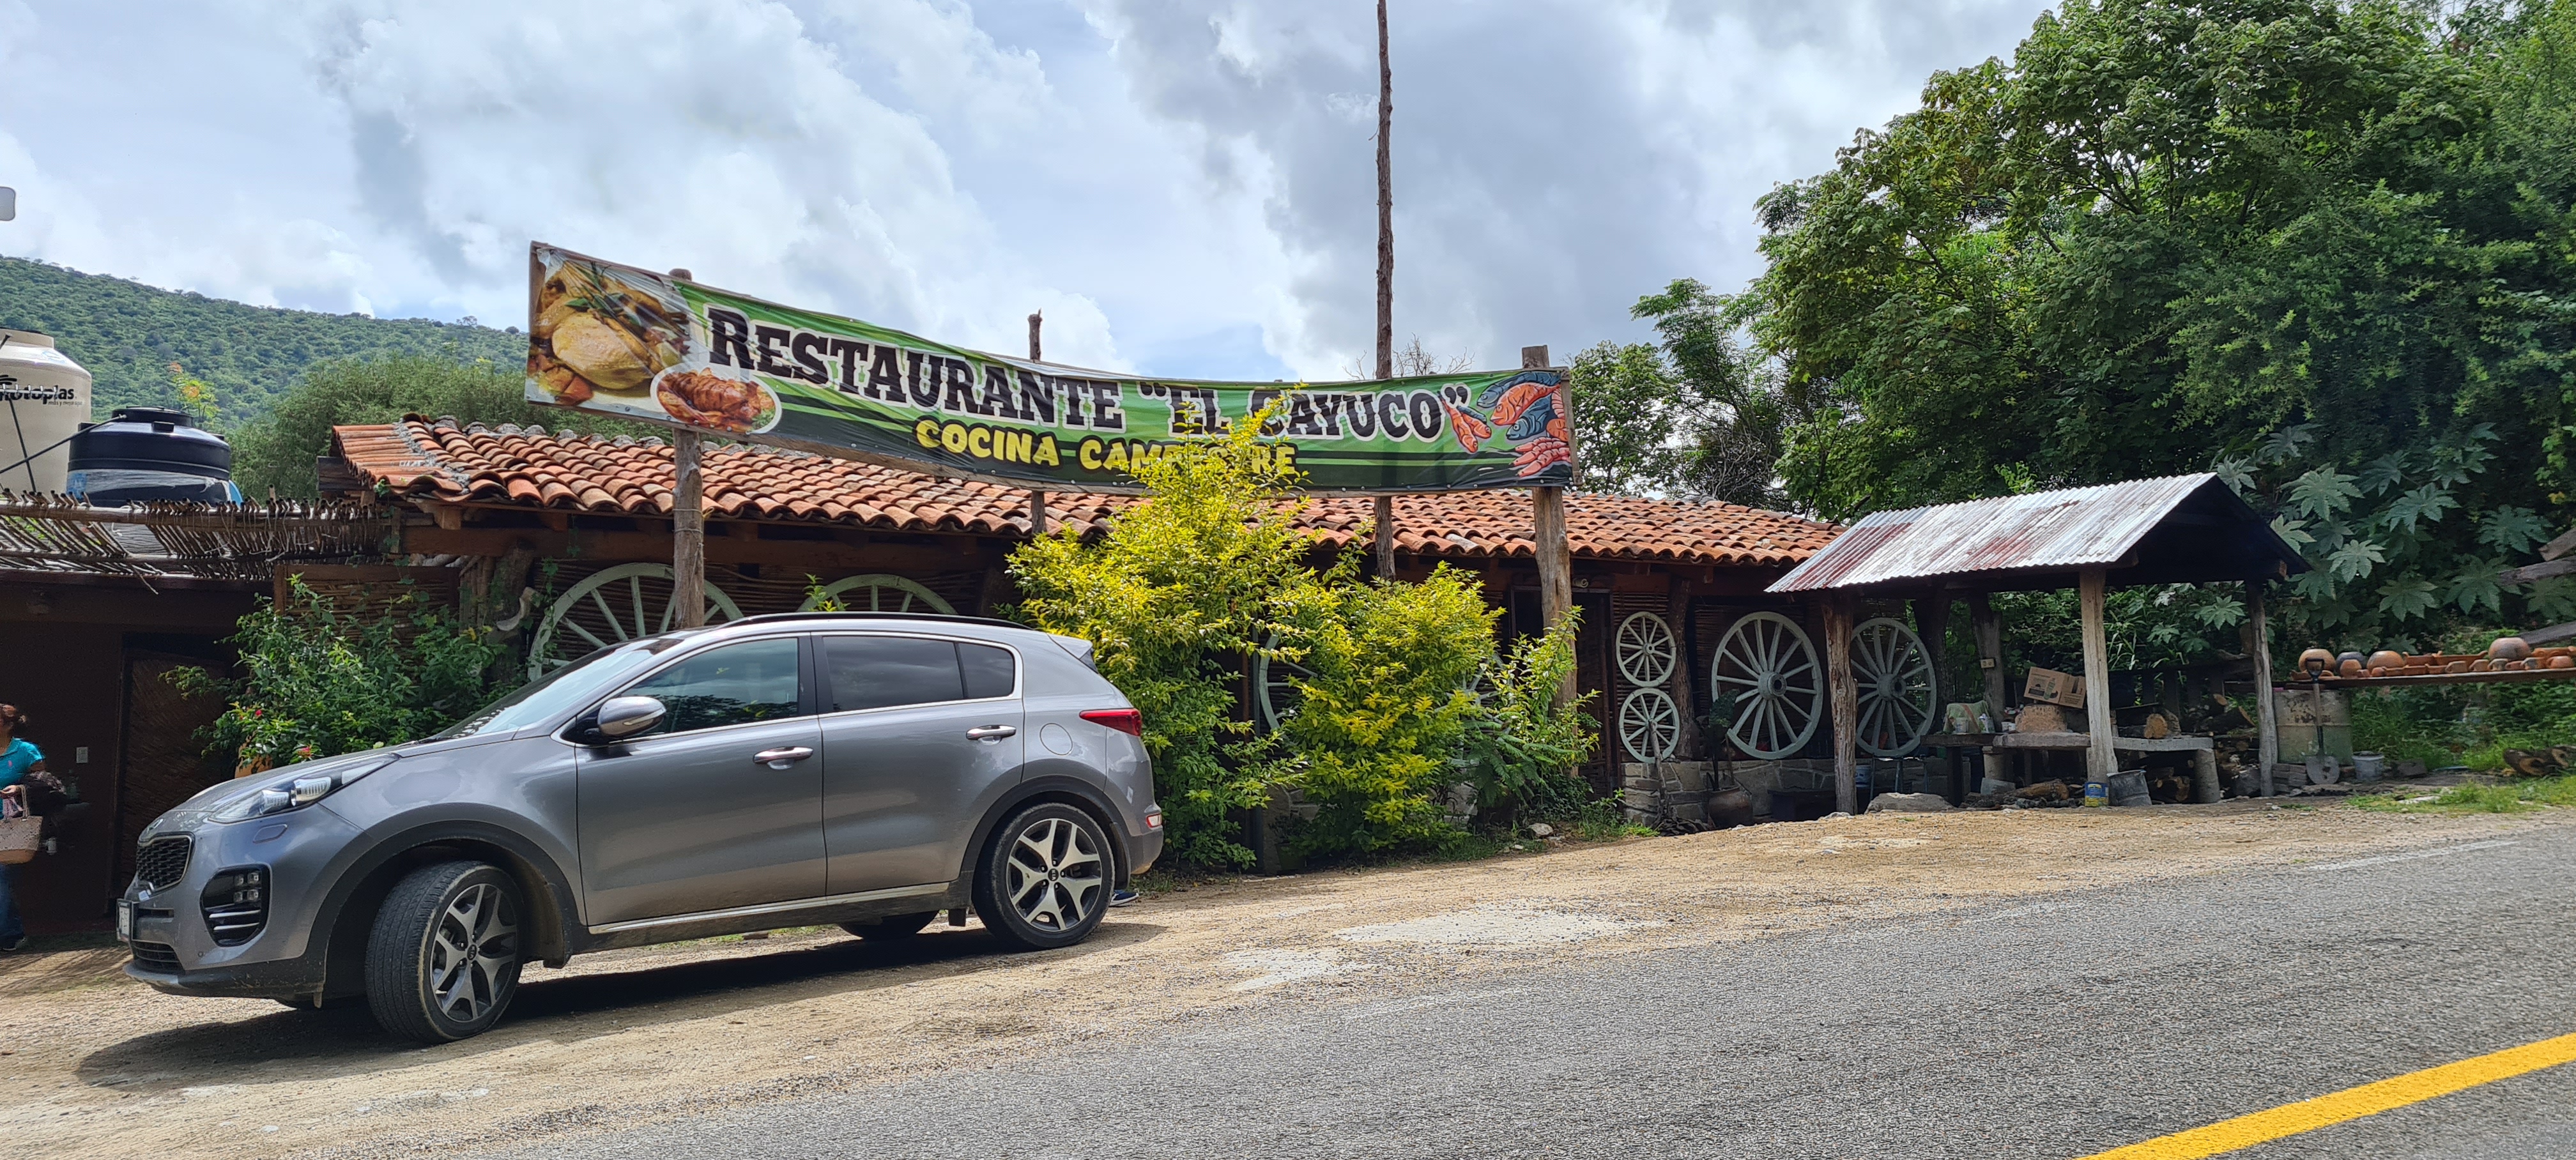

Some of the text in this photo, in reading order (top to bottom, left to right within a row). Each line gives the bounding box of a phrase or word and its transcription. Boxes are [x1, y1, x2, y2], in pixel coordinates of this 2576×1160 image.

[707, 307, 1123, 429] RESTAURANTE
[916, 419, 1296, 474] COCINA CAMPSRE
